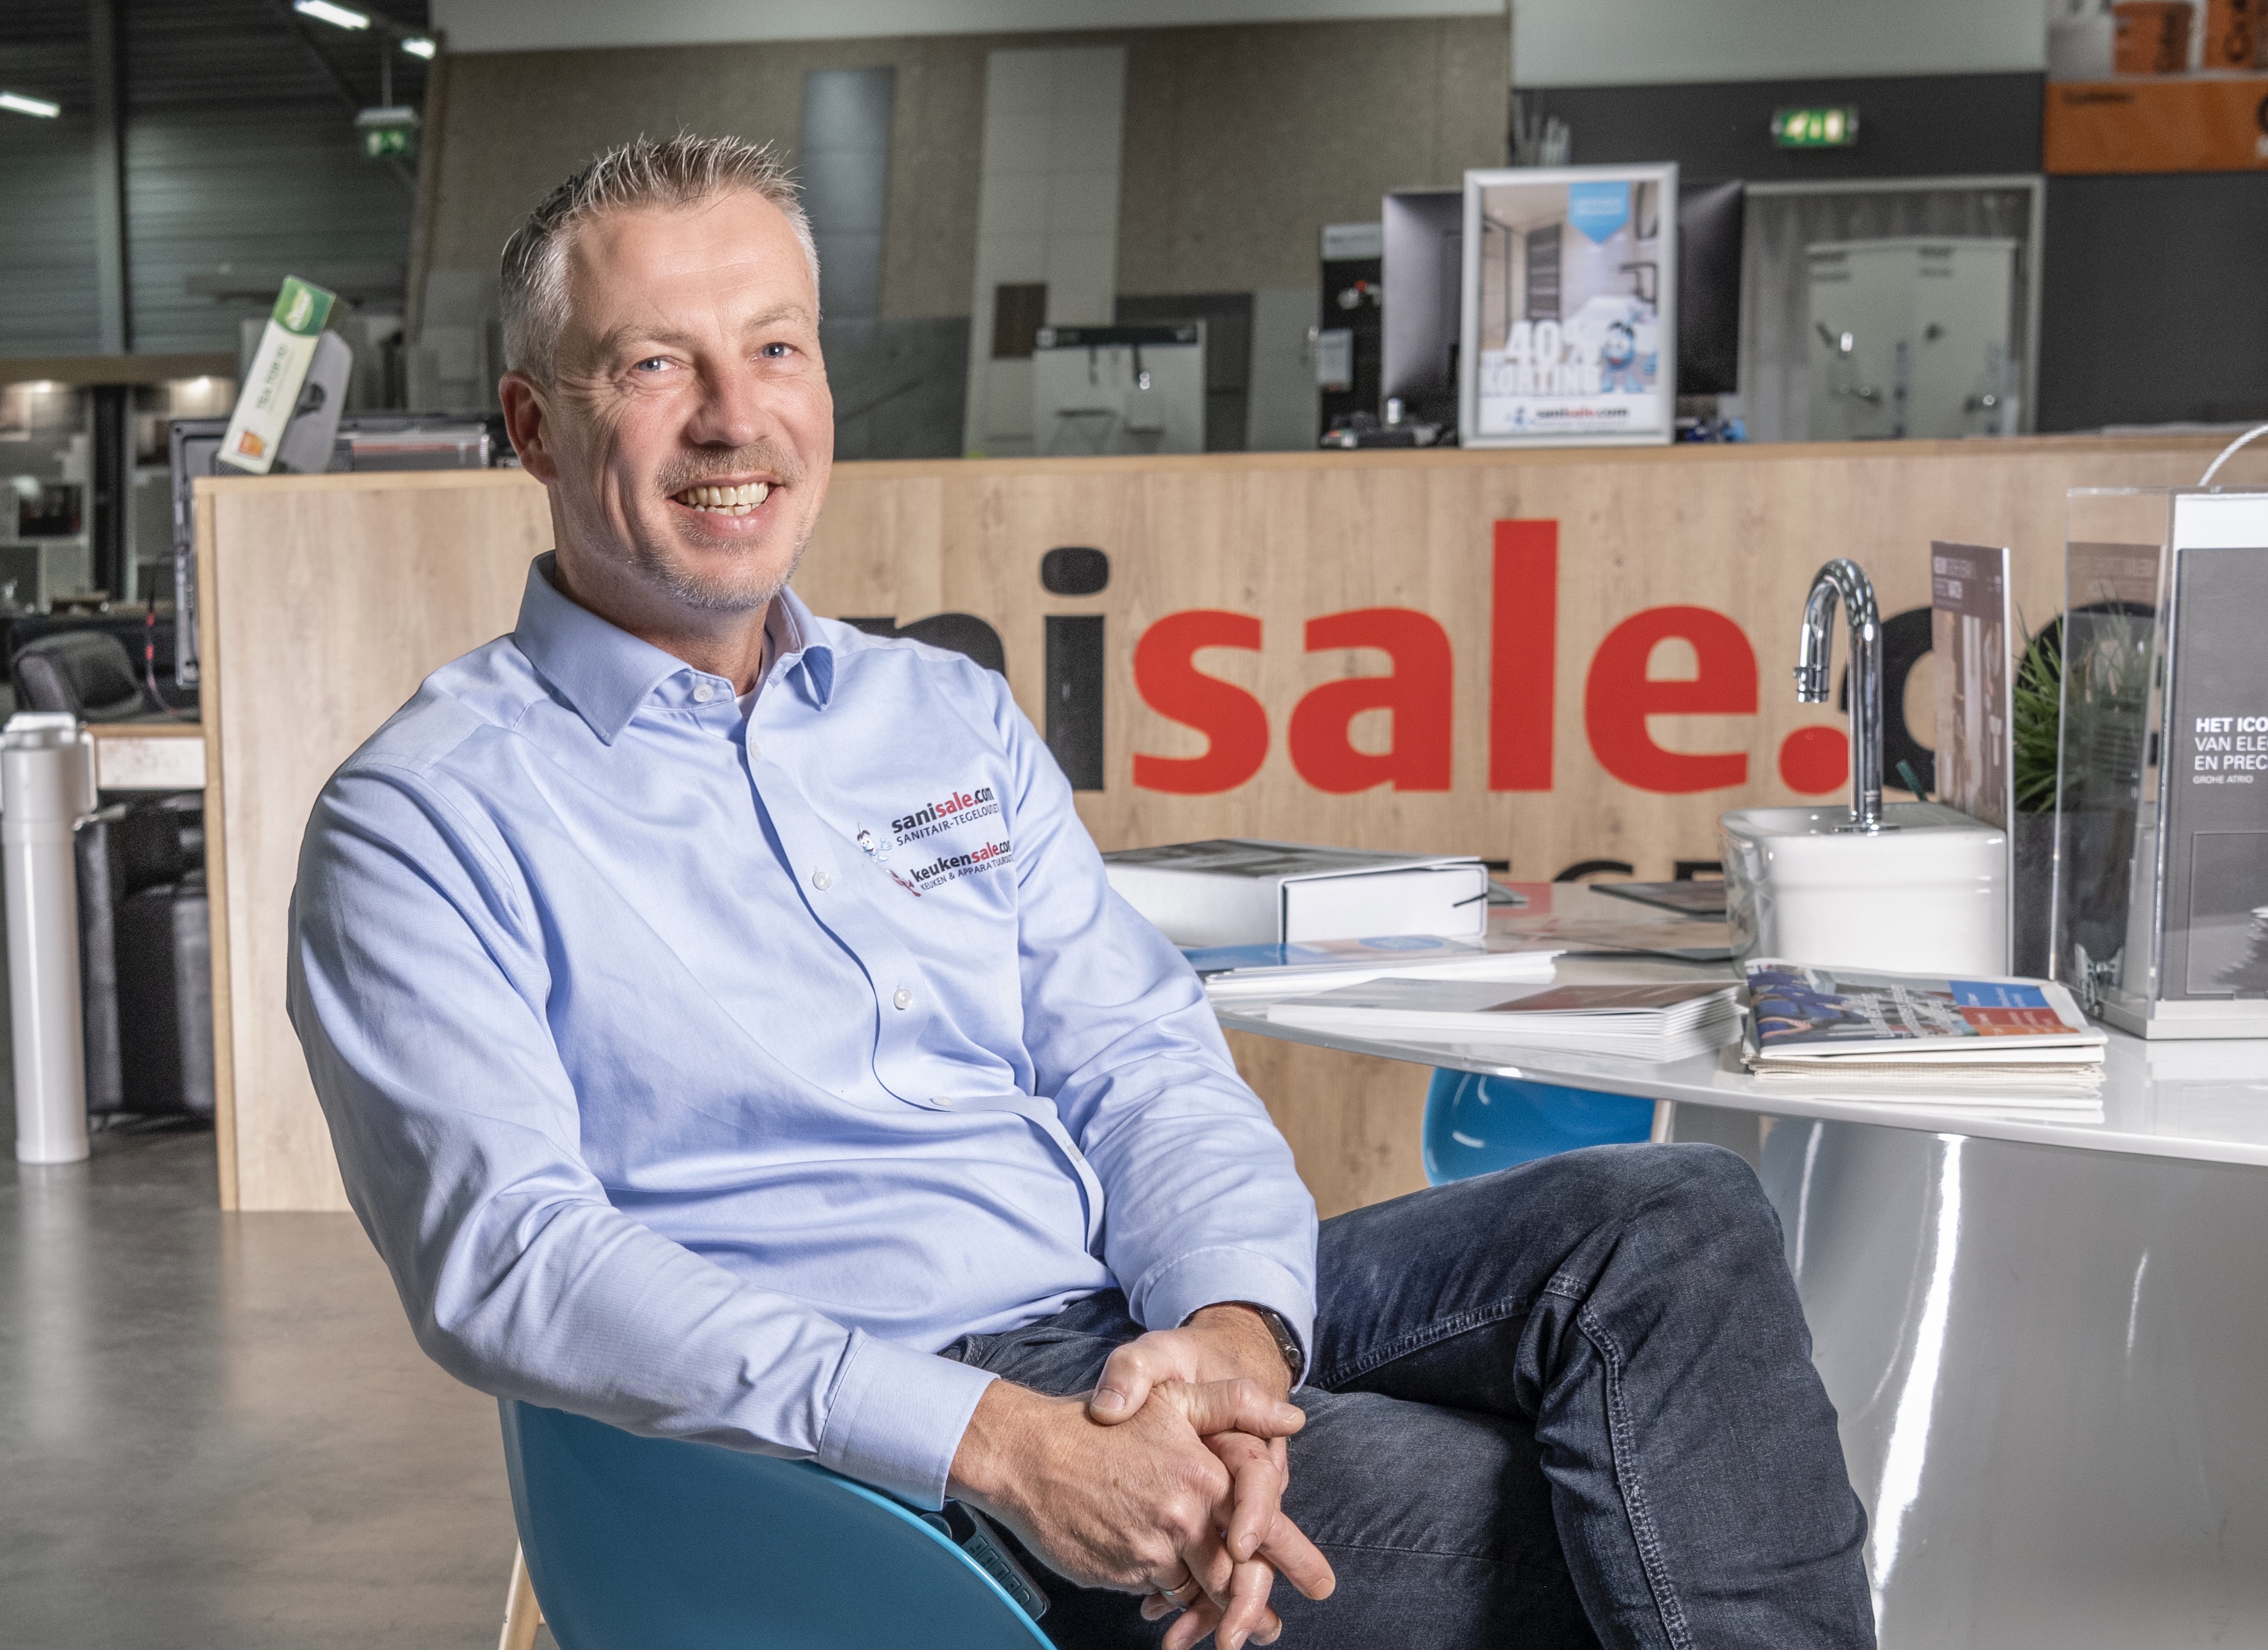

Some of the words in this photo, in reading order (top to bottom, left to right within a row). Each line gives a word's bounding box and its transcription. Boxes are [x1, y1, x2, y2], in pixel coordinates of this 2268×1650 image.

[2195, 717, 2233, 732] HET
[2237, 716, 2268, 732] ICO
[2194, 736, 2231, 751] VAN
[2236, 735, 2268, 751] ELE
[2194, 755, 2218, 771] EN
[2223, 754, 2268, 770] PREC
[2192, 775, 2226, 784] GROHE
[2226, 775, 2254, 784] ATRIO
[892, 787, 994, 834] sanisale.com
[920, 875, 947, 891] KEUKEN
